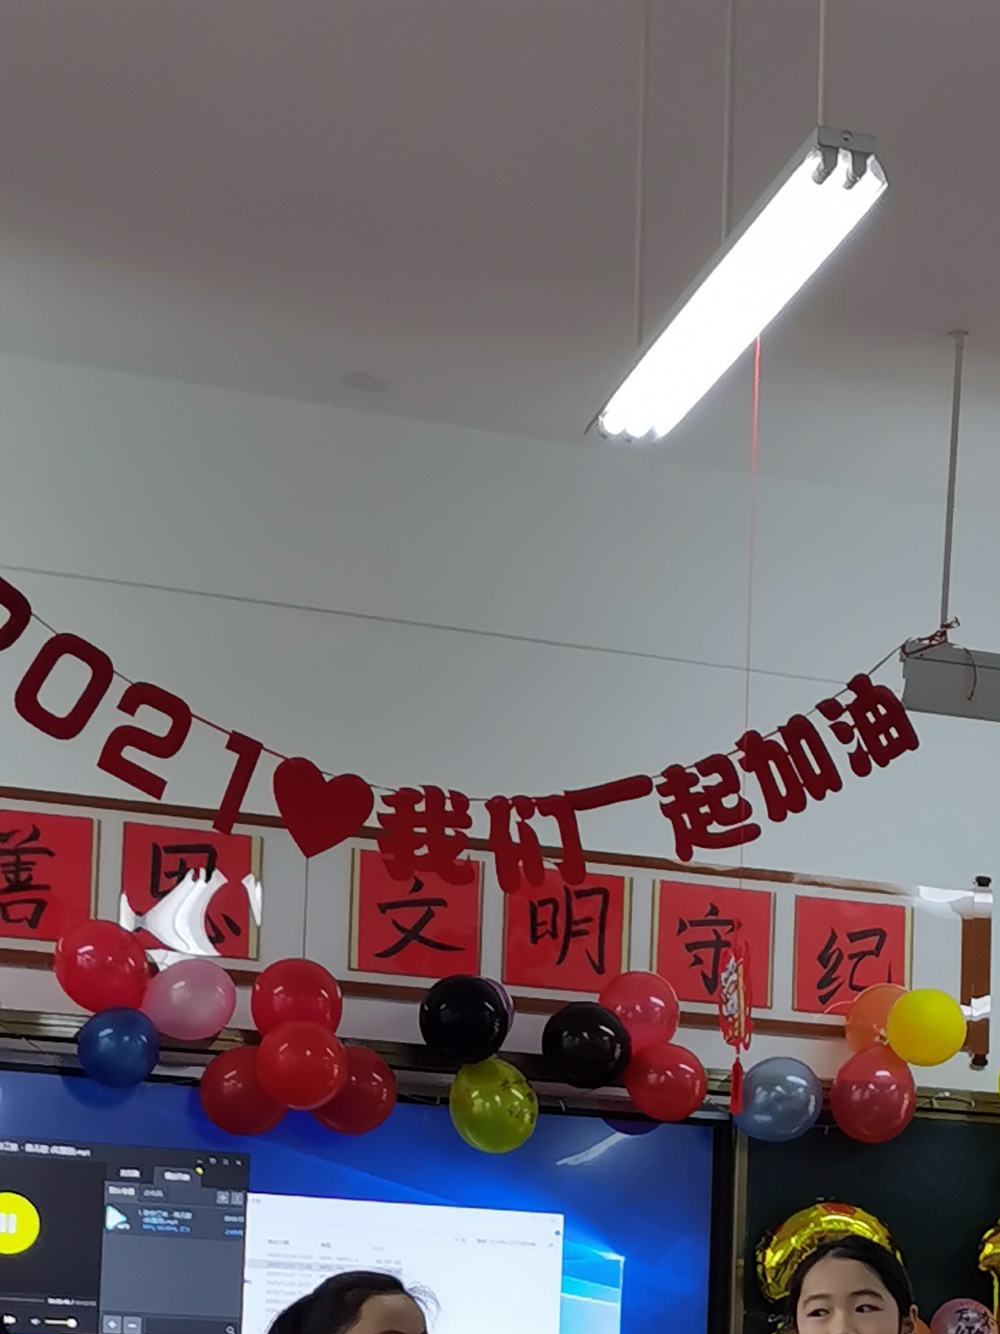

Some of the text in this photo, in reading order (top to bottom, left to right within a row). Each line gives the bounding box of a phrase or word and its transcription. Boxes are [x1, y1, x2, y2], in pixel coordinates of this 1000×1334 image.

[377, 673, 919, 893] 我们一起加油
[374, 876, 894, 1004] 文明守纪
